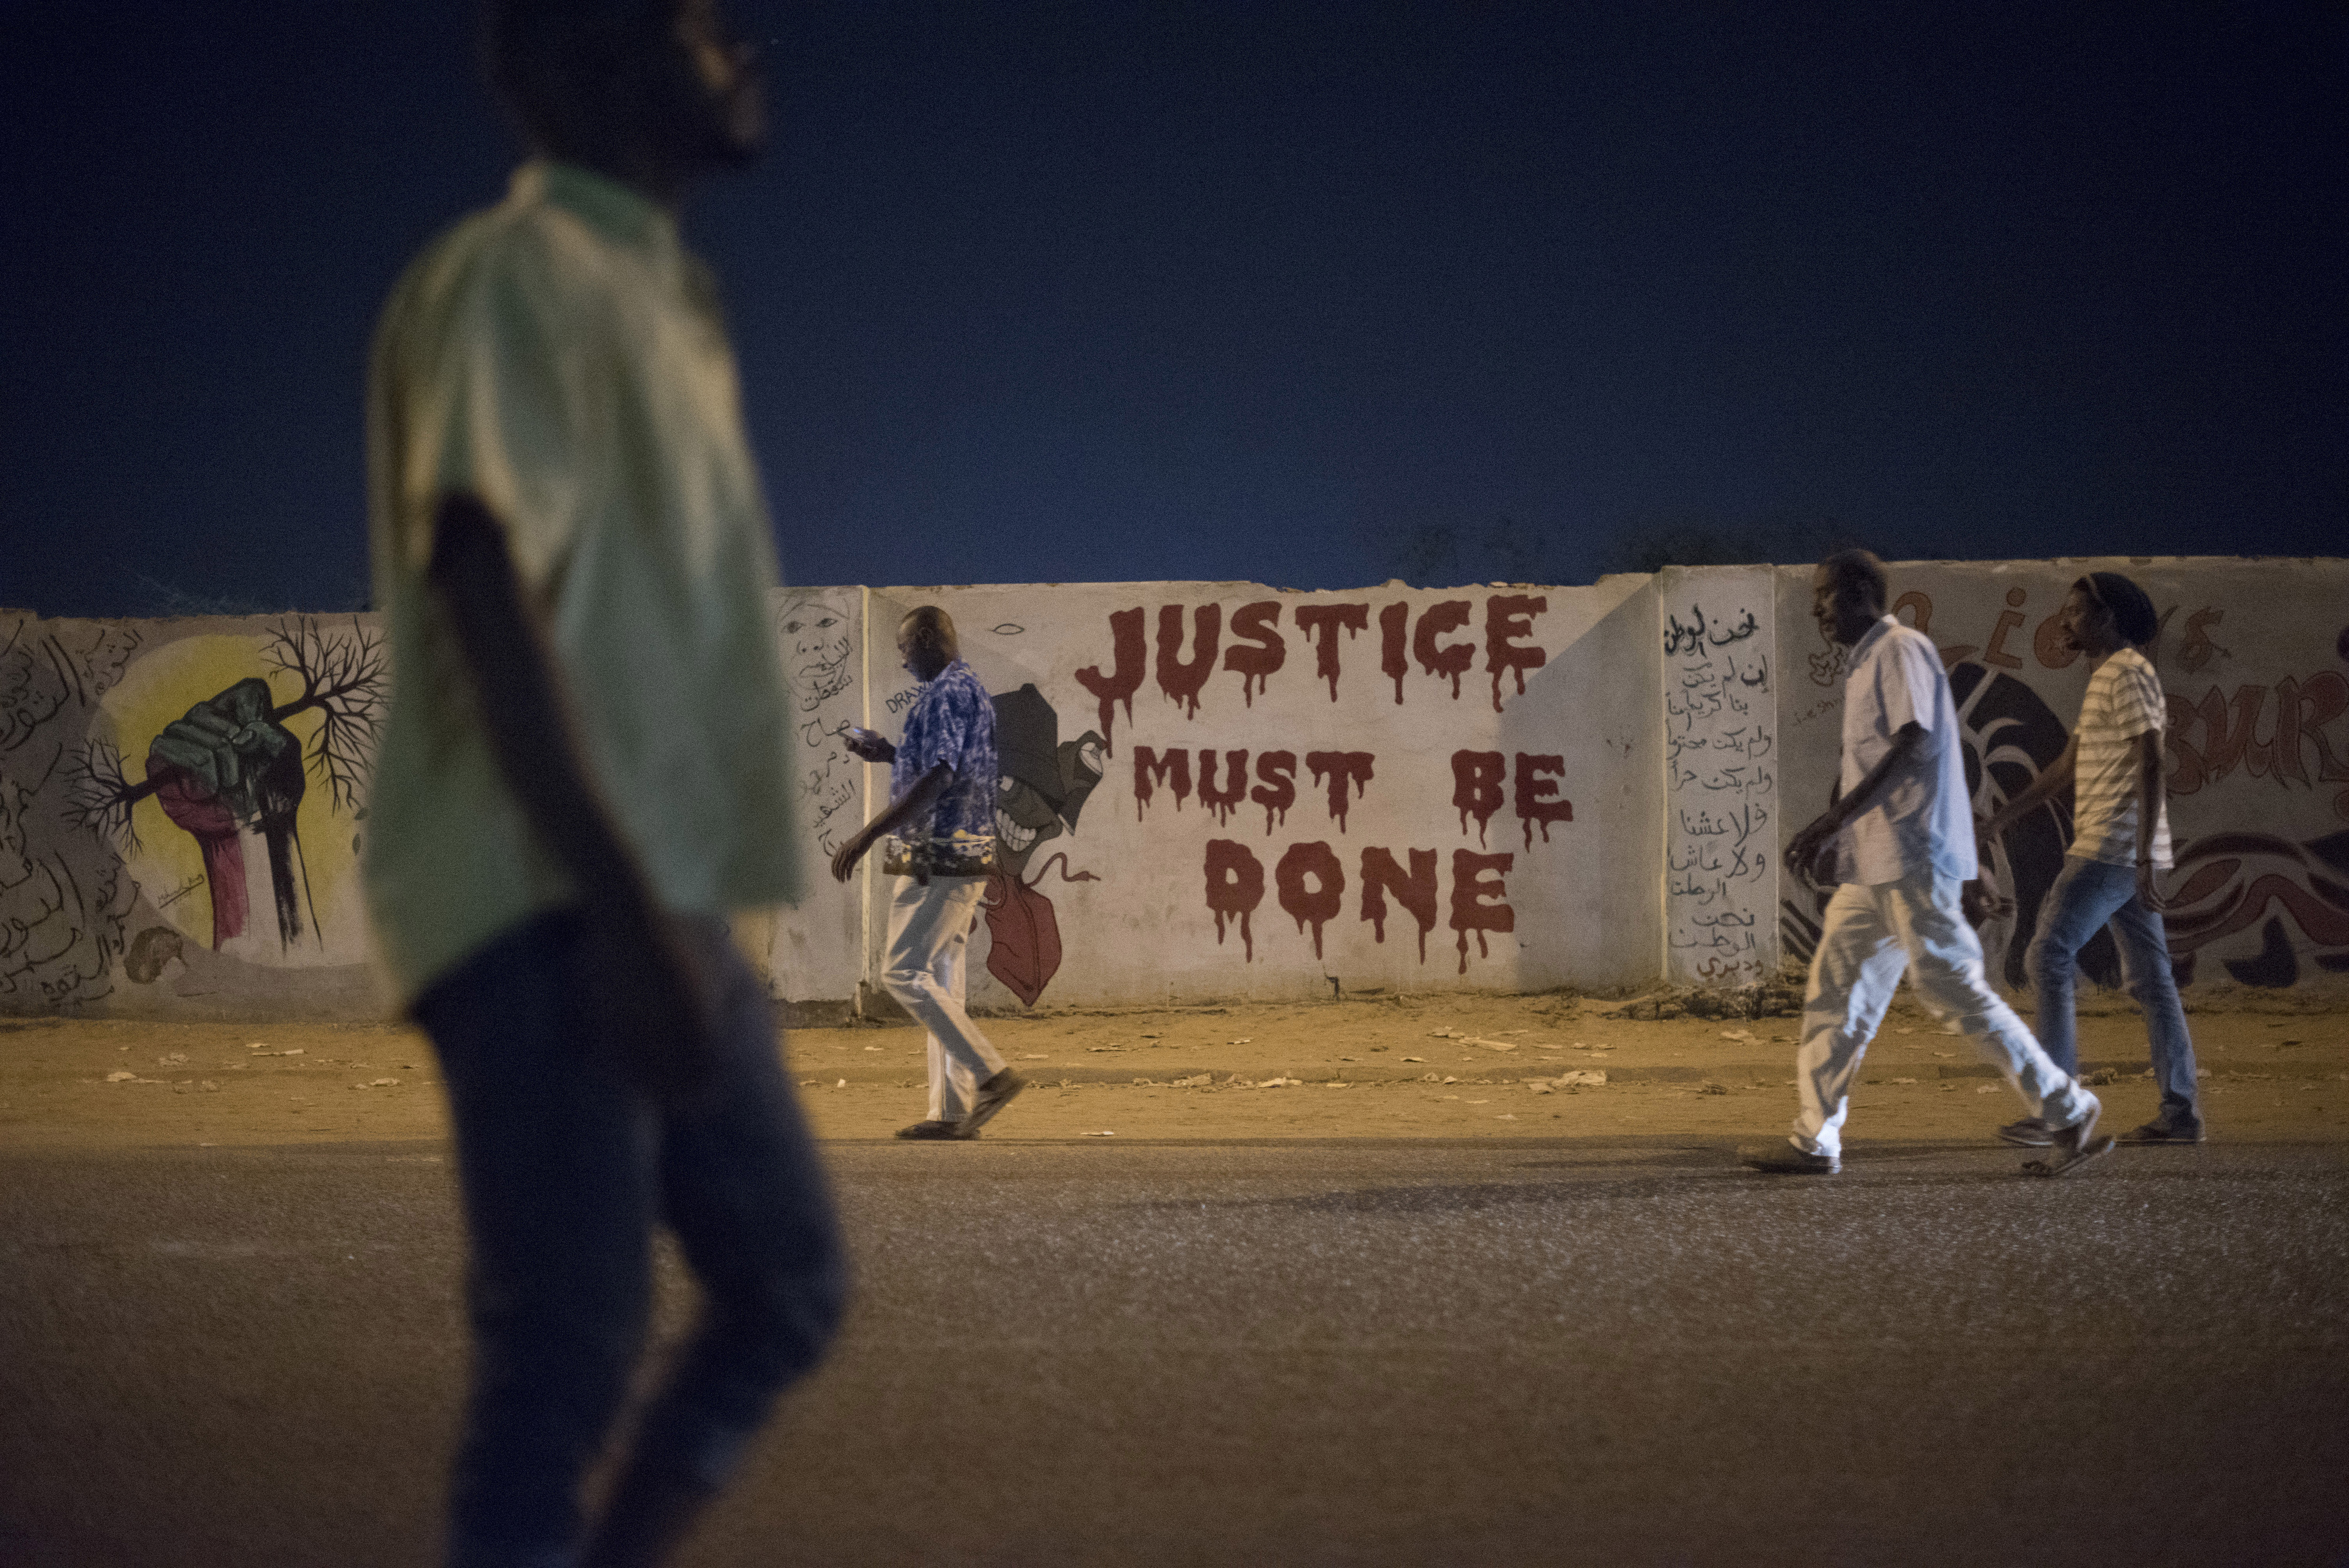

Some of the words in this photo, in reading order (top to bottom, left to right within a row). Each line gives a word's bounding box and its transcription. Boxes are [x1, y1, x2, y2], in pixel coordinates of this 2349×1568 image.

[1074, 595, 1548, 733] JUSTICE
[1133, 746, 1376, 837] MUST
[1451, 749, 1574, 853] BE
[1204, 838, 1516, 975] DONE
